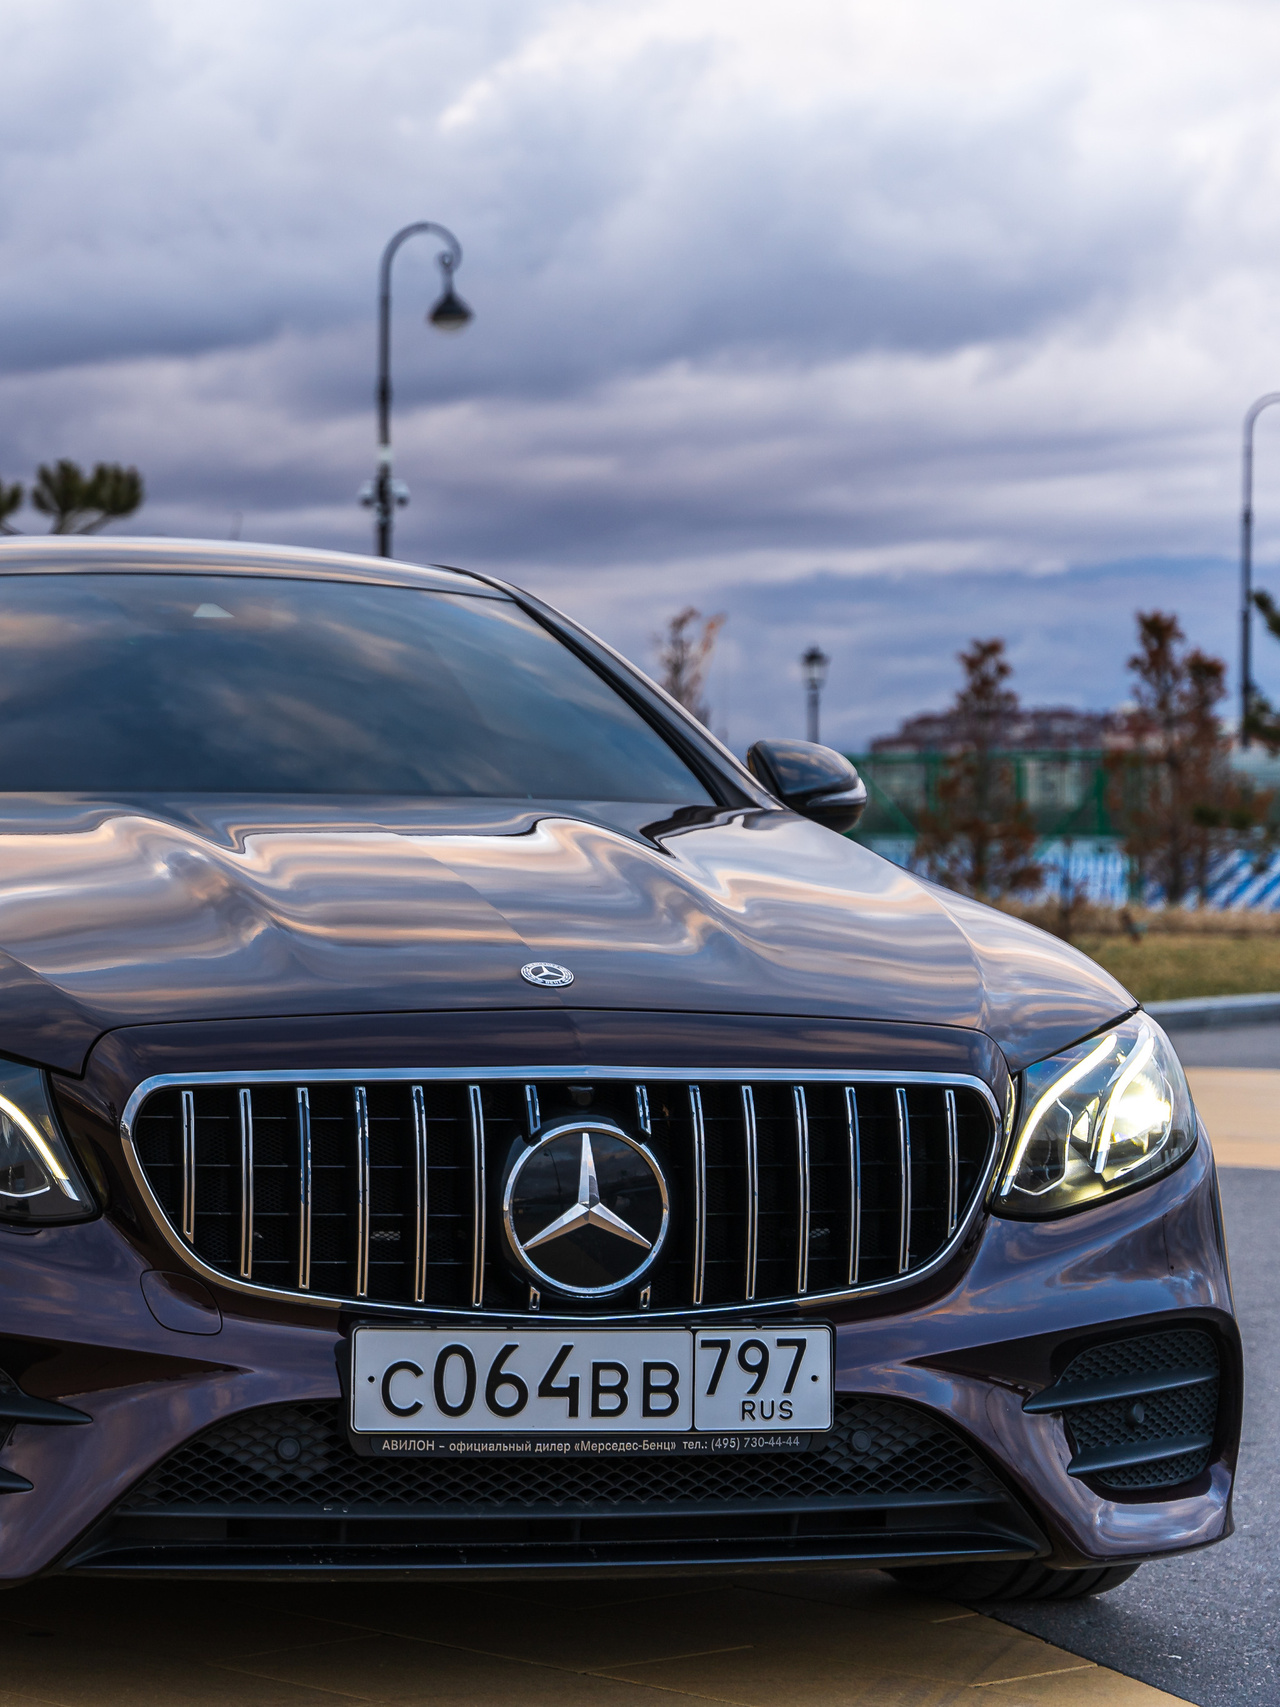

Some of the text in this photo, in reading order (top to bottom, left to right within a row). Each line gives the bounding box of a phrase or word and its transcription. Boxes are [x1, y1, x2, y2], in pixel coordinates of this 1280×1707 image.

[700, 1338, 807, 1396] 797
[740, 1399, 794, 1421] RUS
[382, 1439, 435, 1451] АВИЛОН
[449, 1440, 532, 1454] официальный
[534, 1442, 571, 1454] дилер
[574, 1440, 677, 1454] «Мерседес-Бенц»
[683, 1440, 708, 1450] тел.:
[710, 1437, 741, 1451] (495)
[743, 1435, 800, 1449] 730-44-44
